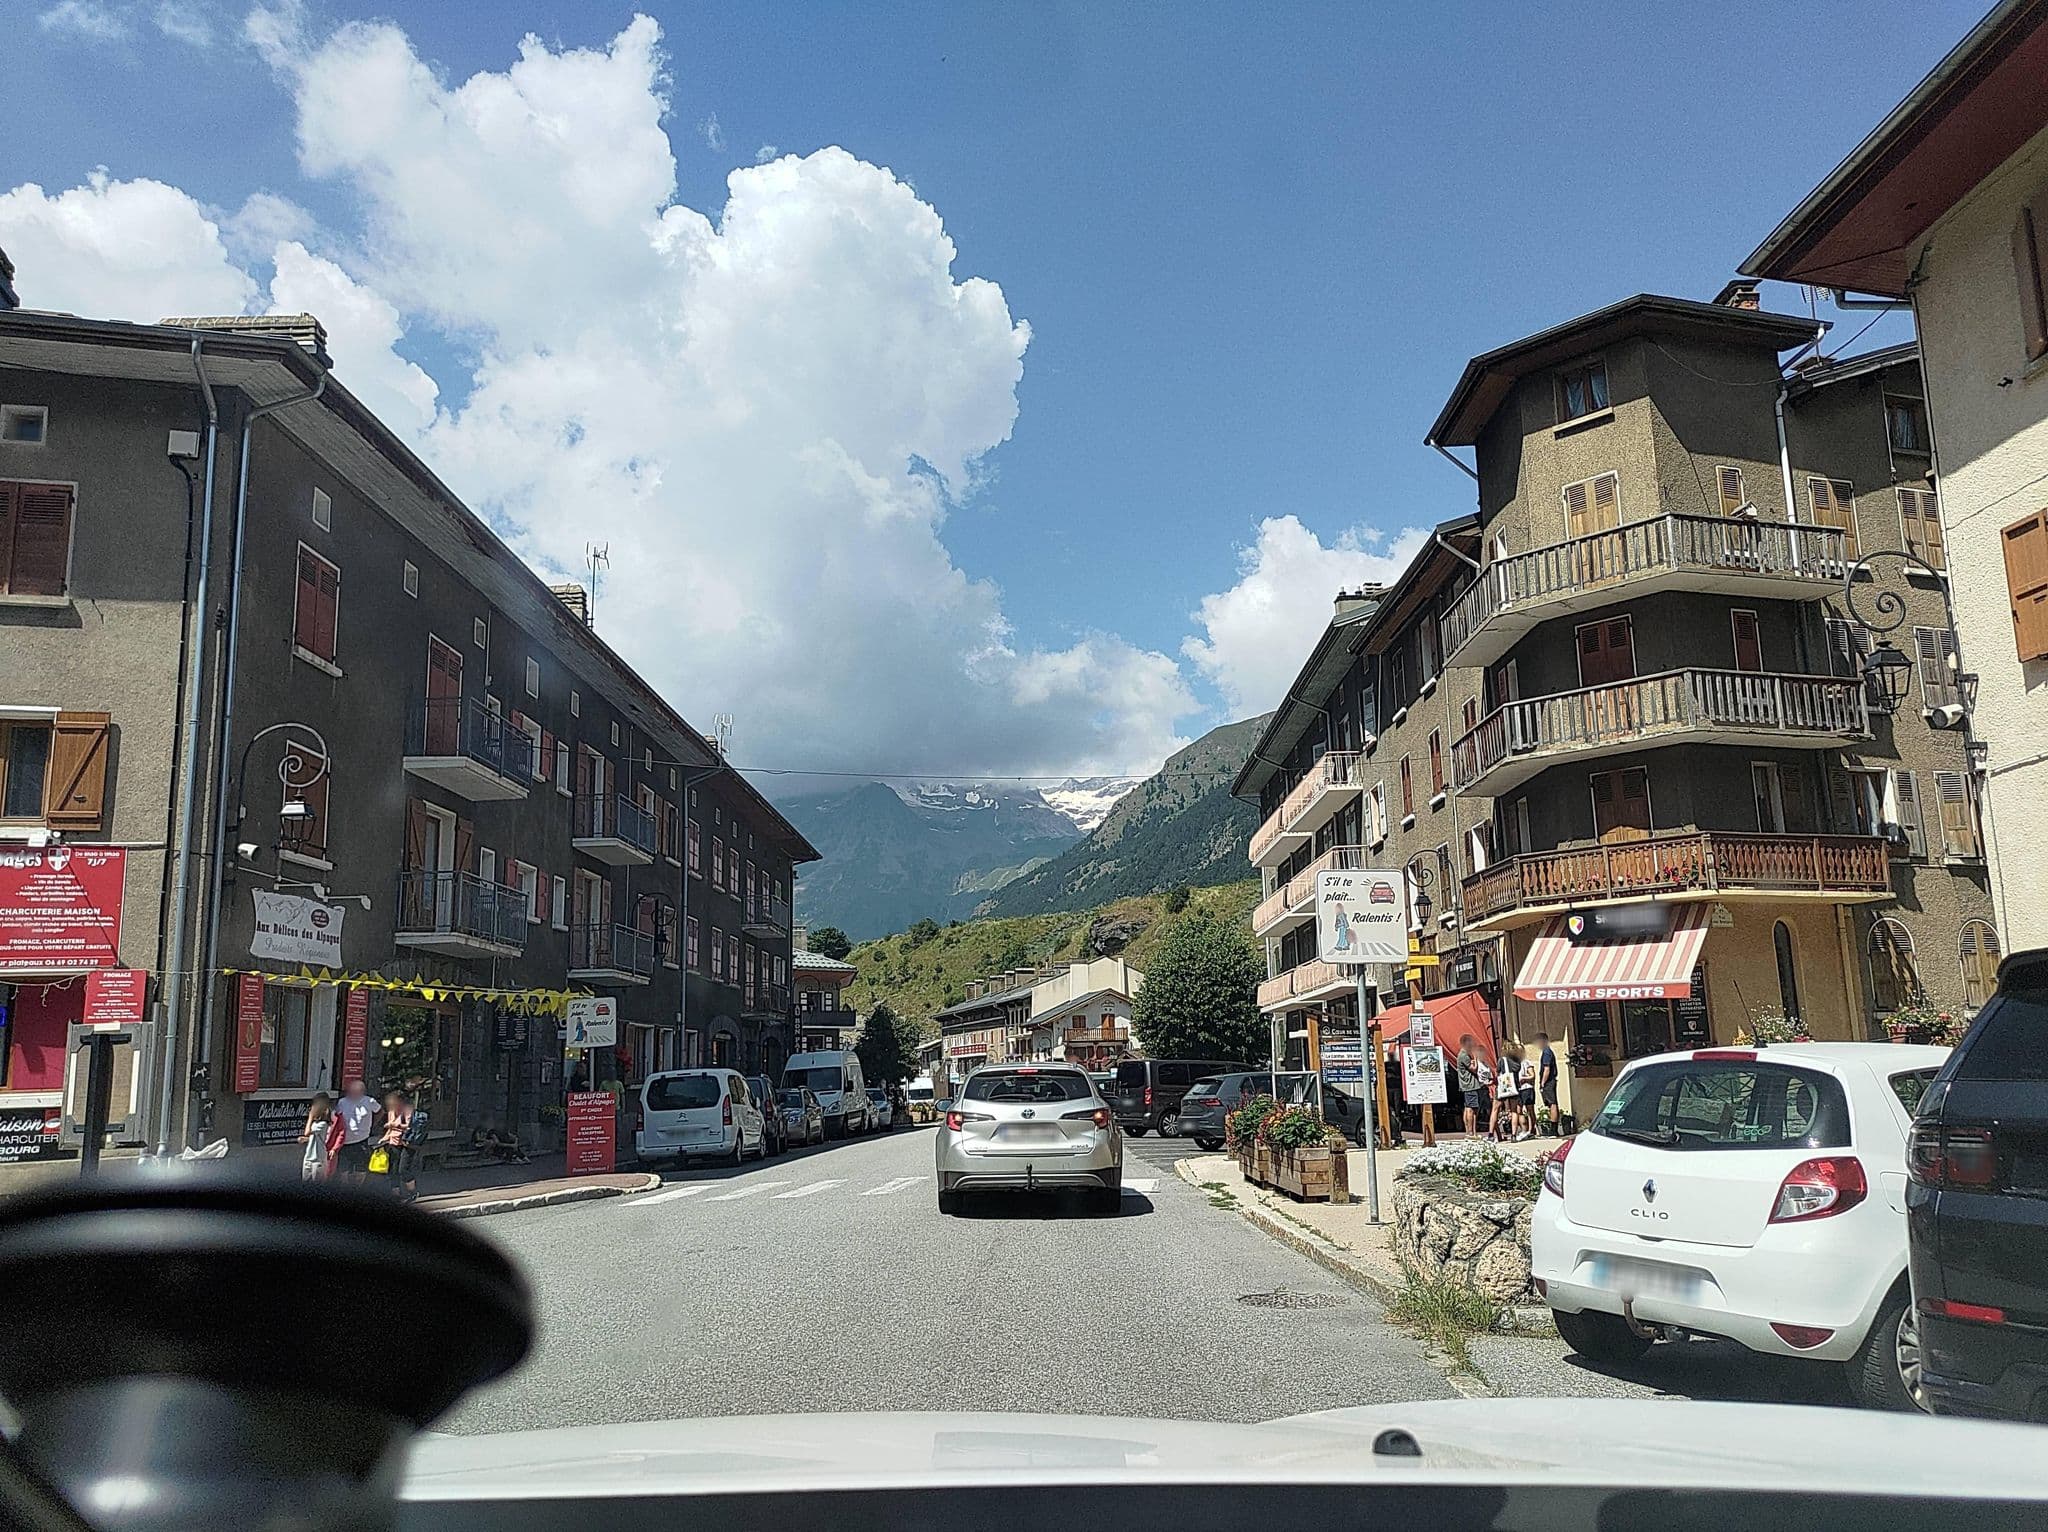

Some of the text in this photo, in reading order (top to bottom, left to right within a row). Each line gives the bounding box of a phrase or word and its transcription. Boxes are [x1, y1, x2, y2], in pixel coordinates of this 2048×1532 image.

[1325, 877, 1353, 887] S'il te
[1352, 912, 1402, 923] Ralentis !
[256, 920, 270, 933] Aux
[273, 923, 299, 938] Délices
[301, 928, 314, 940] des
[1535, 986, 1665, 1000] CESAR SPORTS
[573, 1092, 611, 1100] BEAUFORT
[0, 1116, 45, 1132] aison
[1630, 1208, 1670, 1220] CLIO
